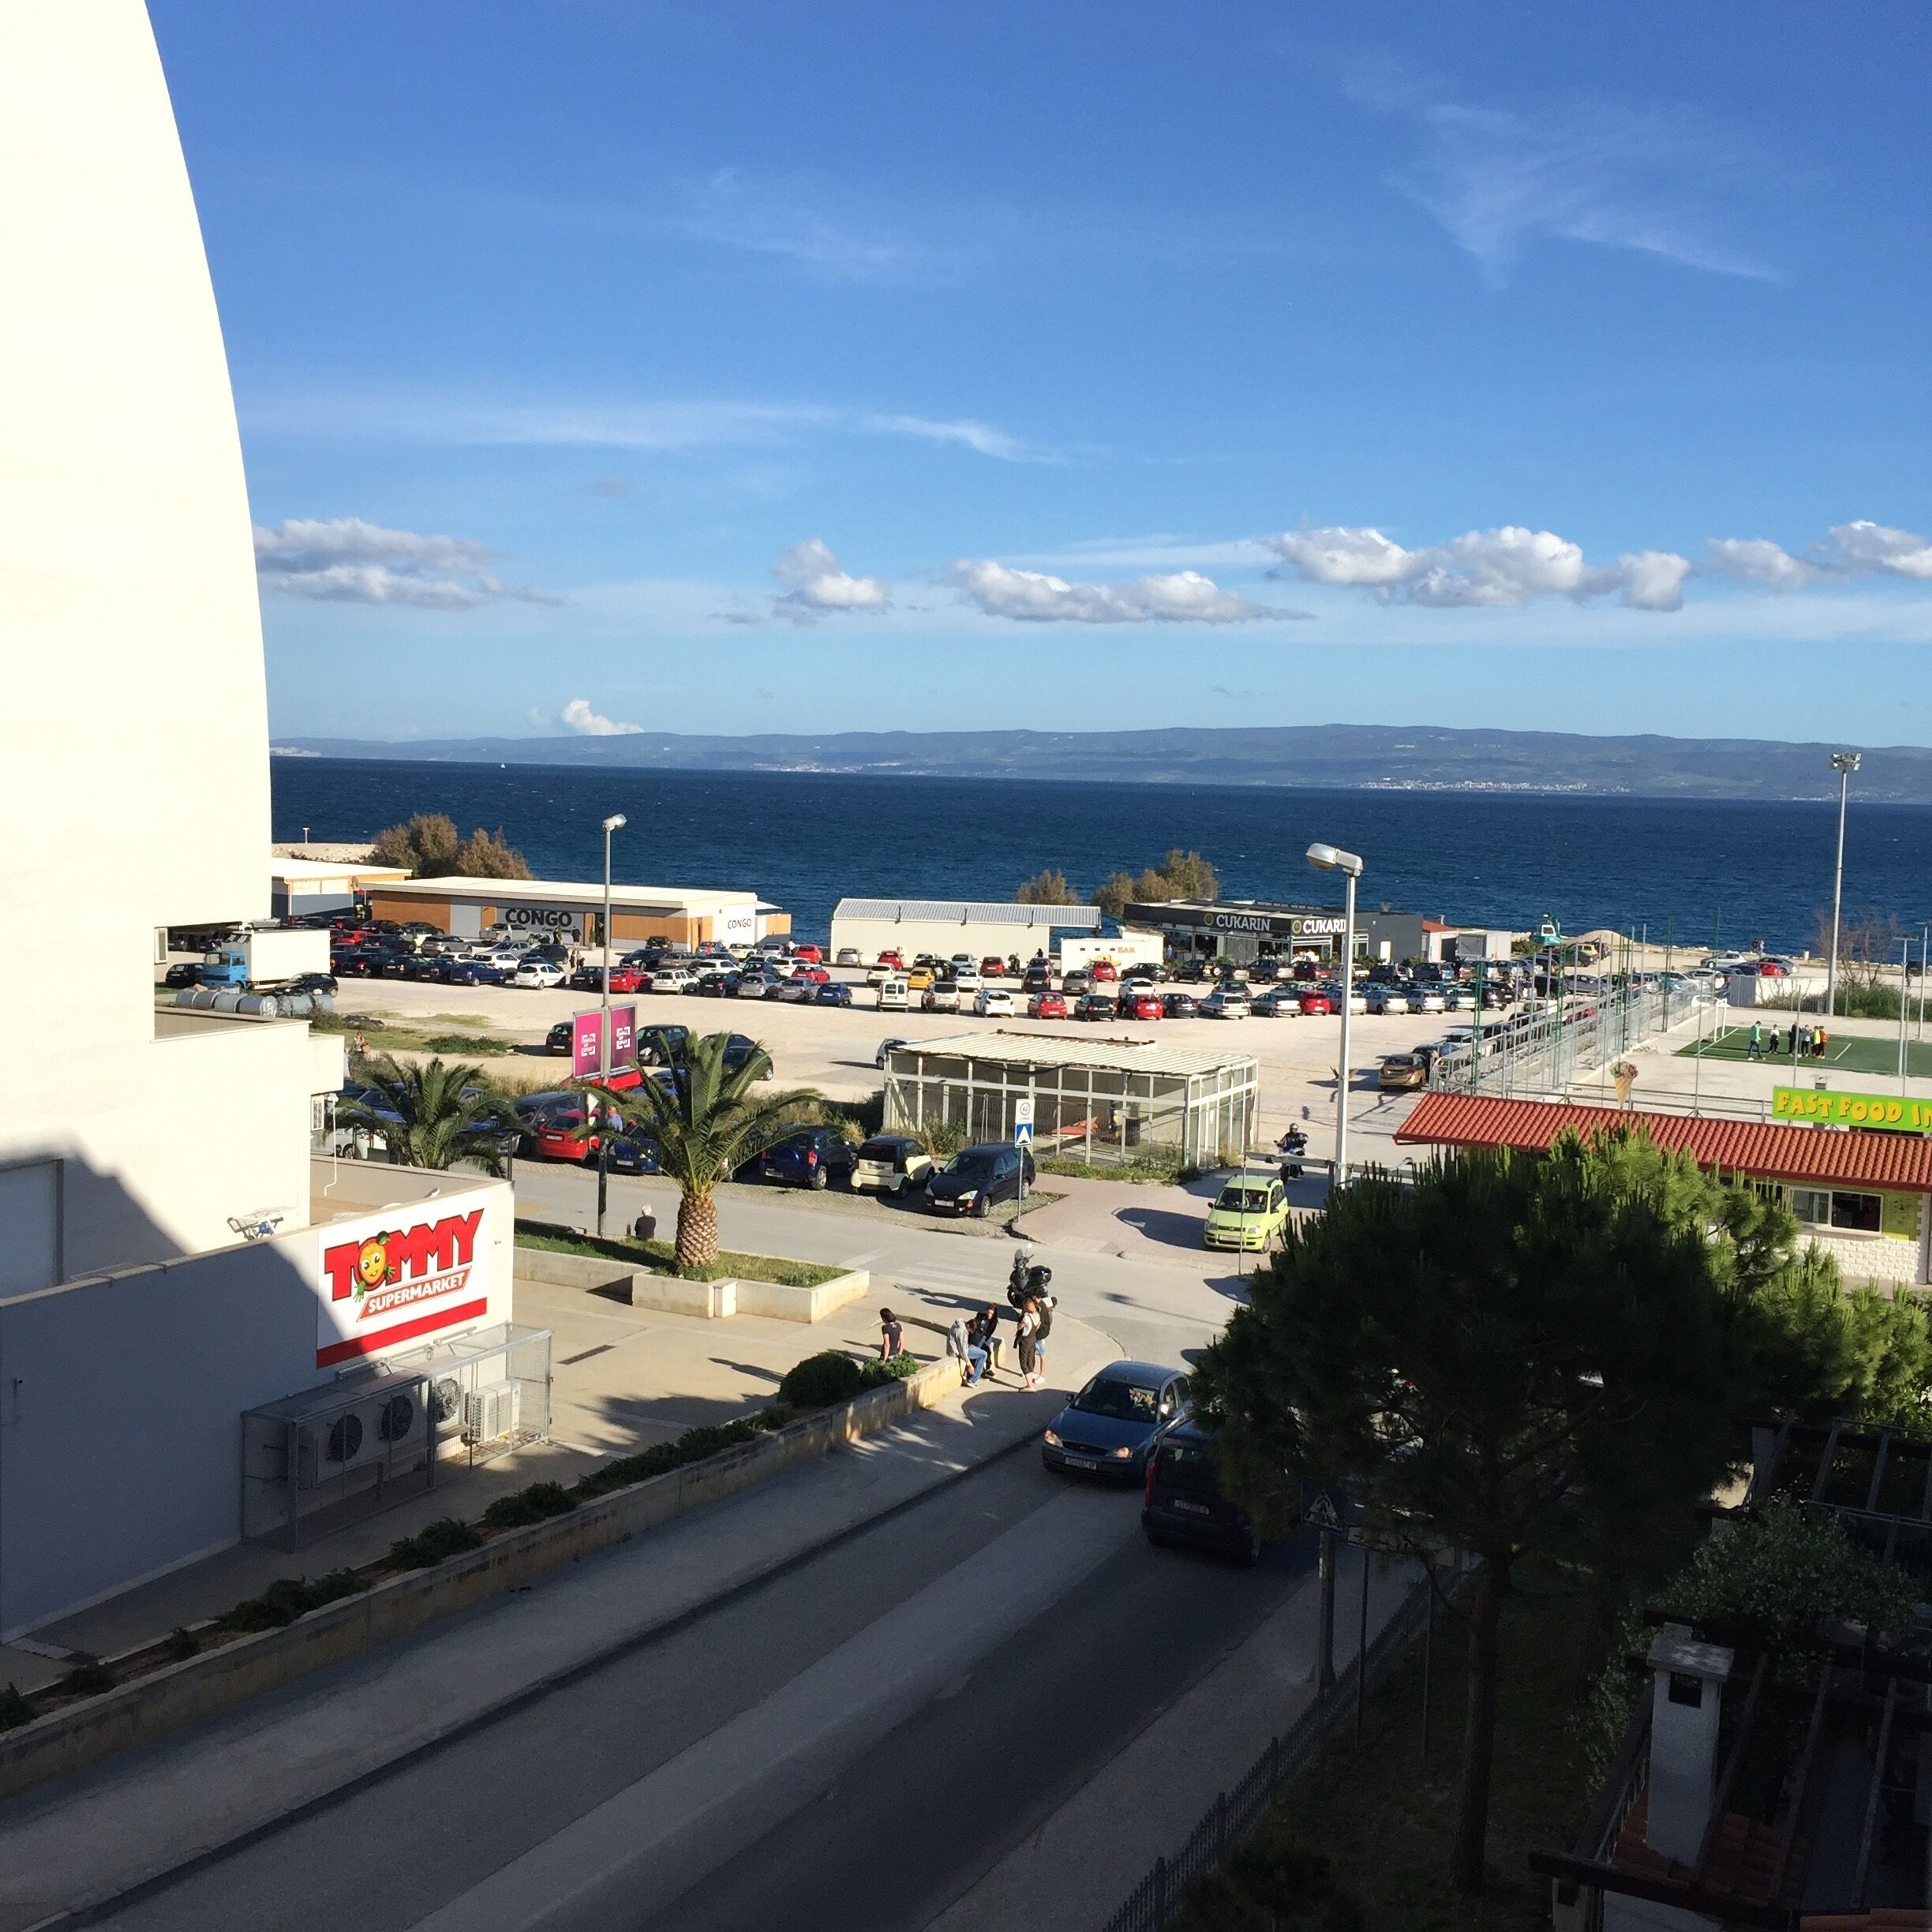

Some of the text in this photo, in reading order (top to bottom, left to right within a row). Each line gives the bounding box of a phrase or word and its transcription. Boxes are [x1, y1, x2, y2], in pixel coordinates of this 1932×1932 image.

[505, 908, 572, 927] CONGO
[727, 918, 752, 930] CONGO
[1216, 915, 1271, 931] CUKARIN
[1303, 919, 1347, 934] CUKARI
[1777, 1091, 1833, 1118] FAST
[1838, 1095, 1903, 1123] FOOD
[324, 1208, 485, 1302] TOMMY
[368, 1272, 466, 1314] SUPERMARKET
